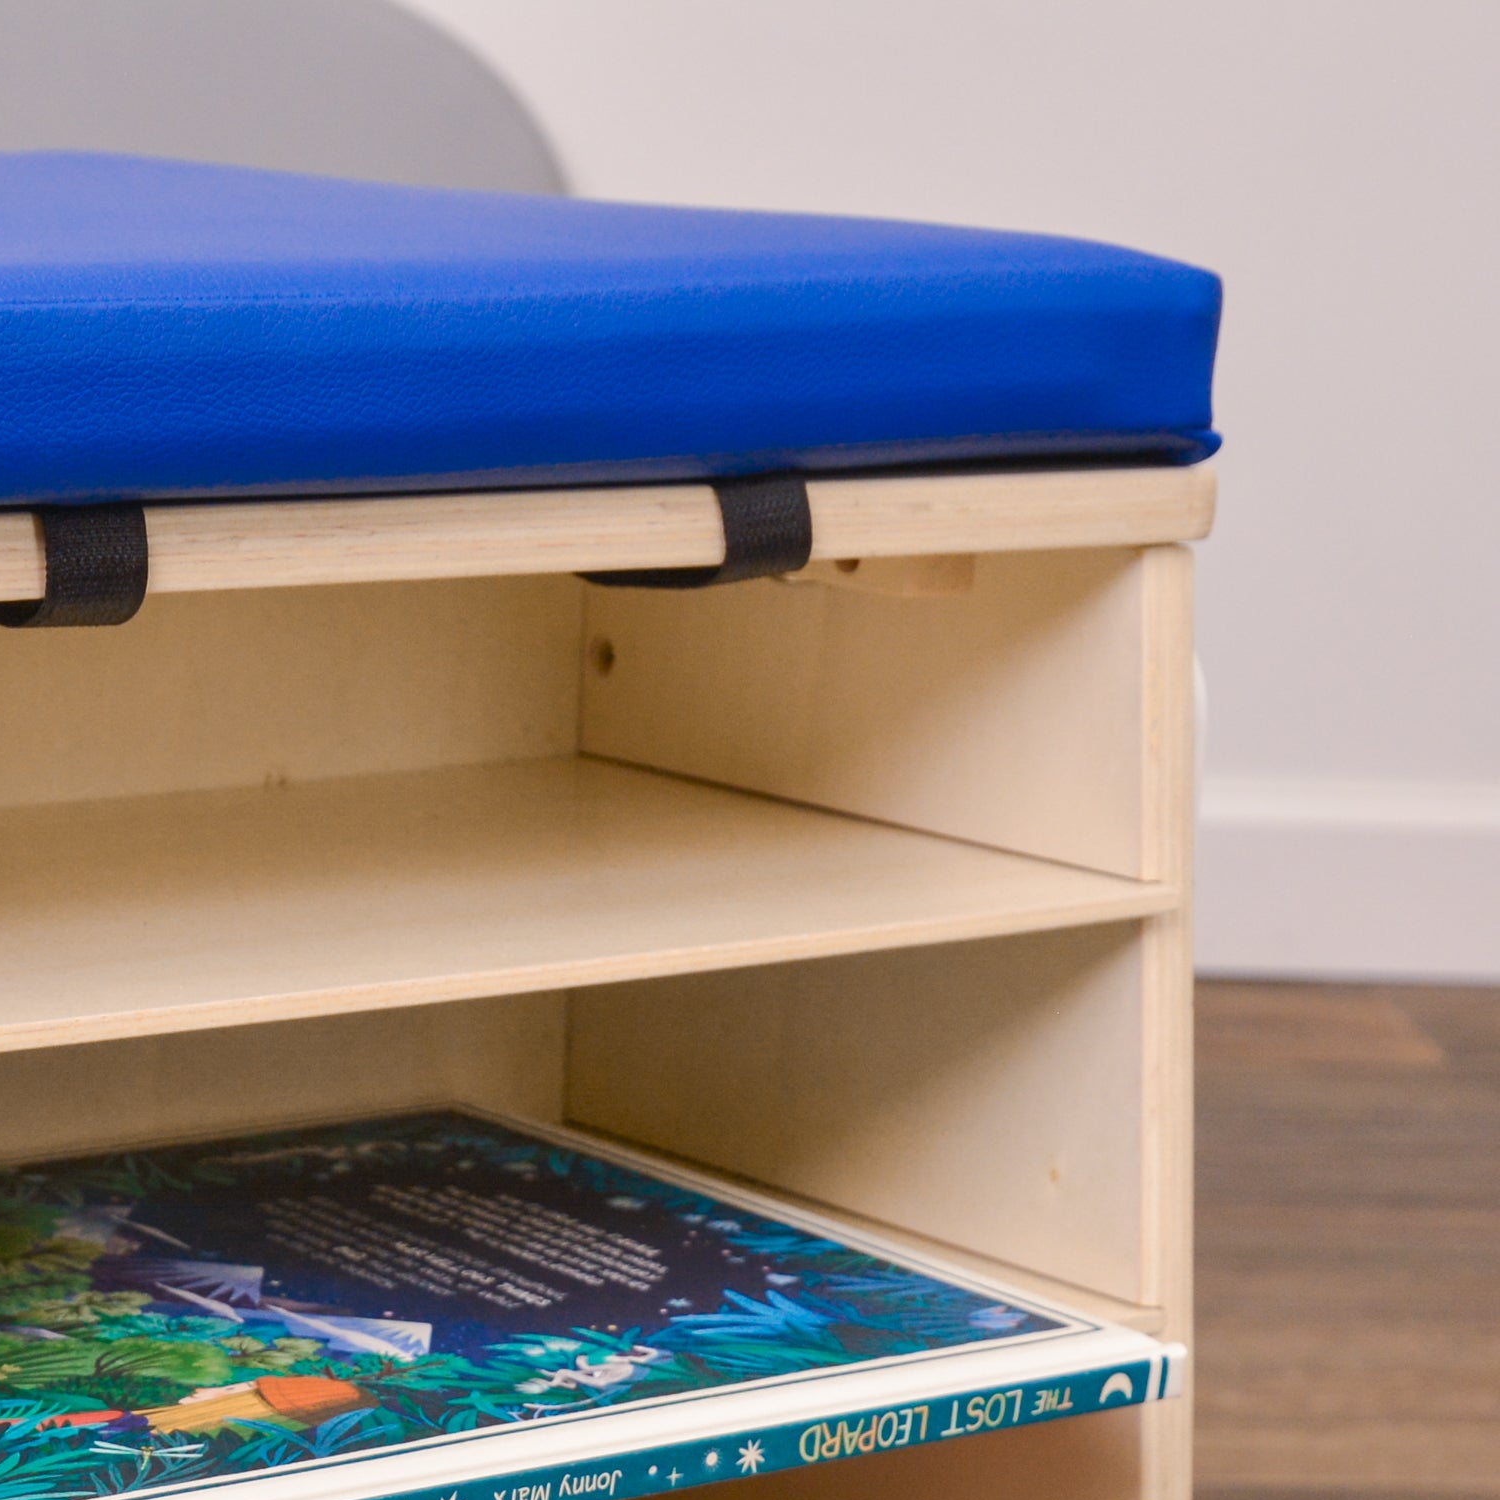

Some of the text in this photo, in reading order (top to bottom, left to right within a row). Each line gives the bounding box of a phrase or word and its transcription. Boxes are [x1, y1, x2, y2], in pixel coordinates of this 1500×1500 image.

[799, 1385, 1075, 1464] THE LOST LEOPARD
[558, 1468, 623, 1498] Jonny
